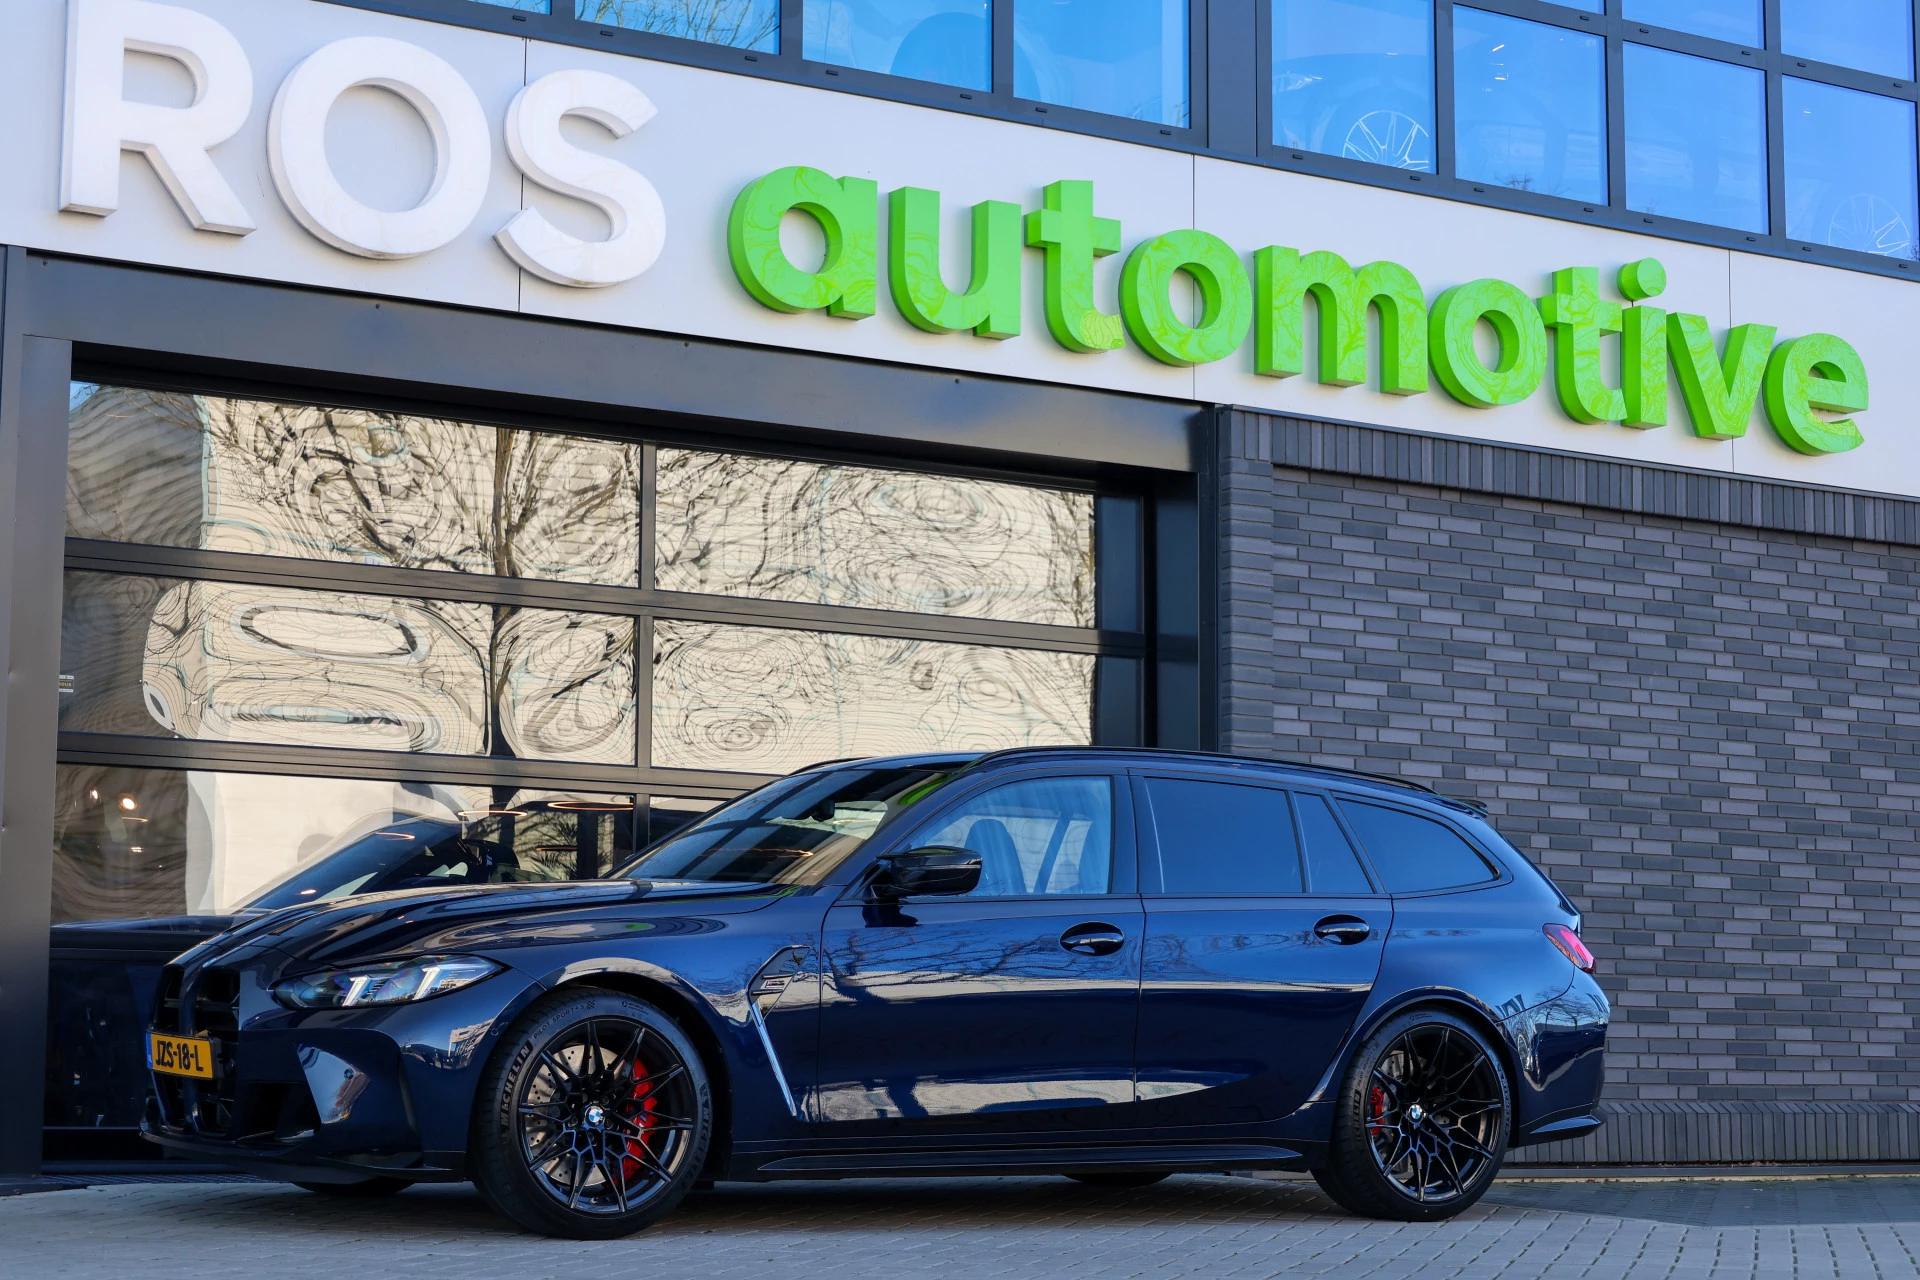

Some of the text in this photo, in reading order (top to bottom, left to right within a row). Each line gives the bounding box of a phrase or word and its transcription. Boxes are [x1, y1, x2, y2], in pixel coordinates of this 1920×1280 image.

[59, 0, 1869, 457] ROS automotive
[534, 1022, 551, 1039] PILOT
[552, 1008, 574, 1023] SPORT
[156, 1040, 204, 1072] JZS-18-L
[500, 1044, 531, 1127] MICHELIN
